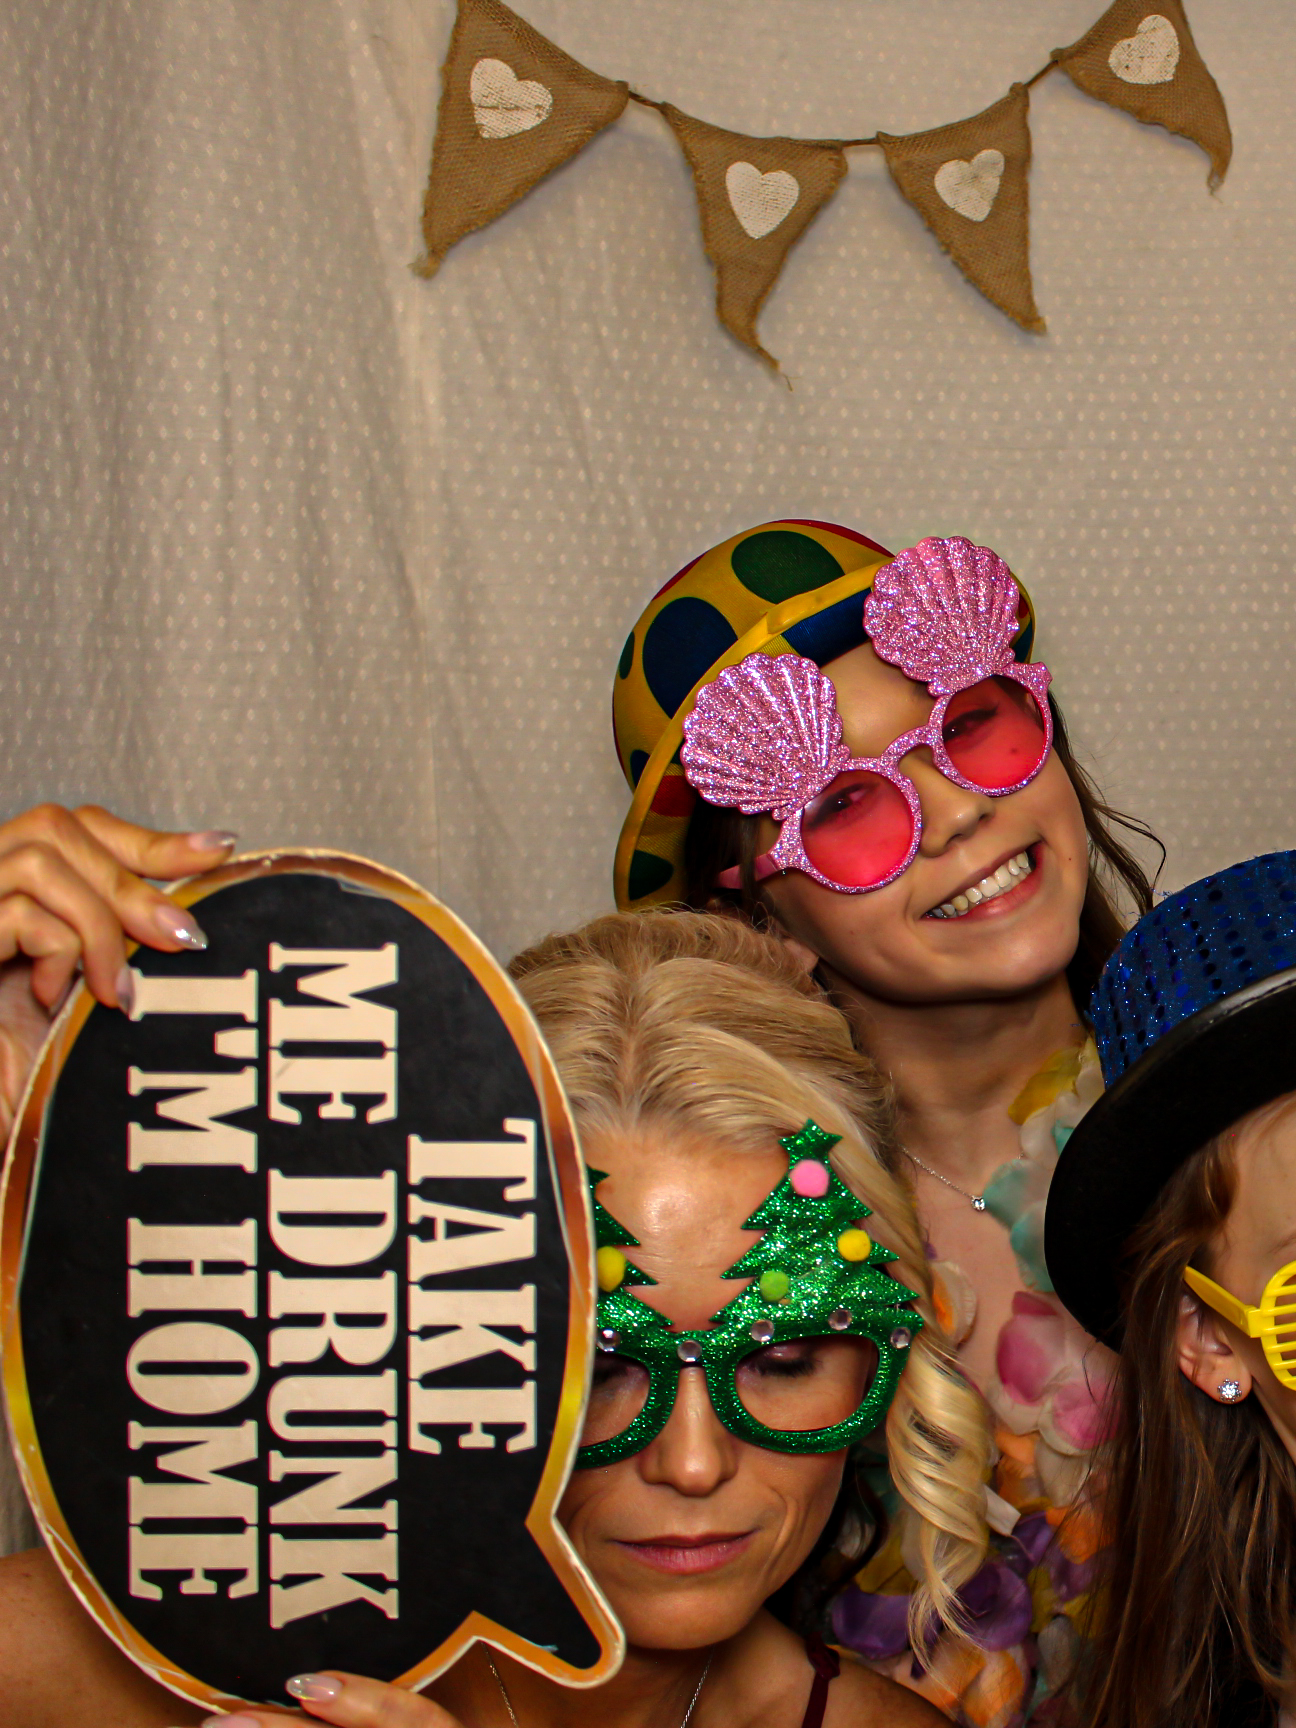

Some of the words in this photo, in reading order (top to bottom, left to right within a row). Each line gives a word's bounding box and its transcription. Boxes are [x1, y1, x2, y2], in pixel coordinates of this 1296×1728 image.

[127, 968, 259, 1174] I'M
[267, 942, 399, 1125] ME
[126, 1217, 260, 1601] HOME
[266, 1169, 400, 1630] DRUNK
[408, 1117, 537, 1455] TAKE
